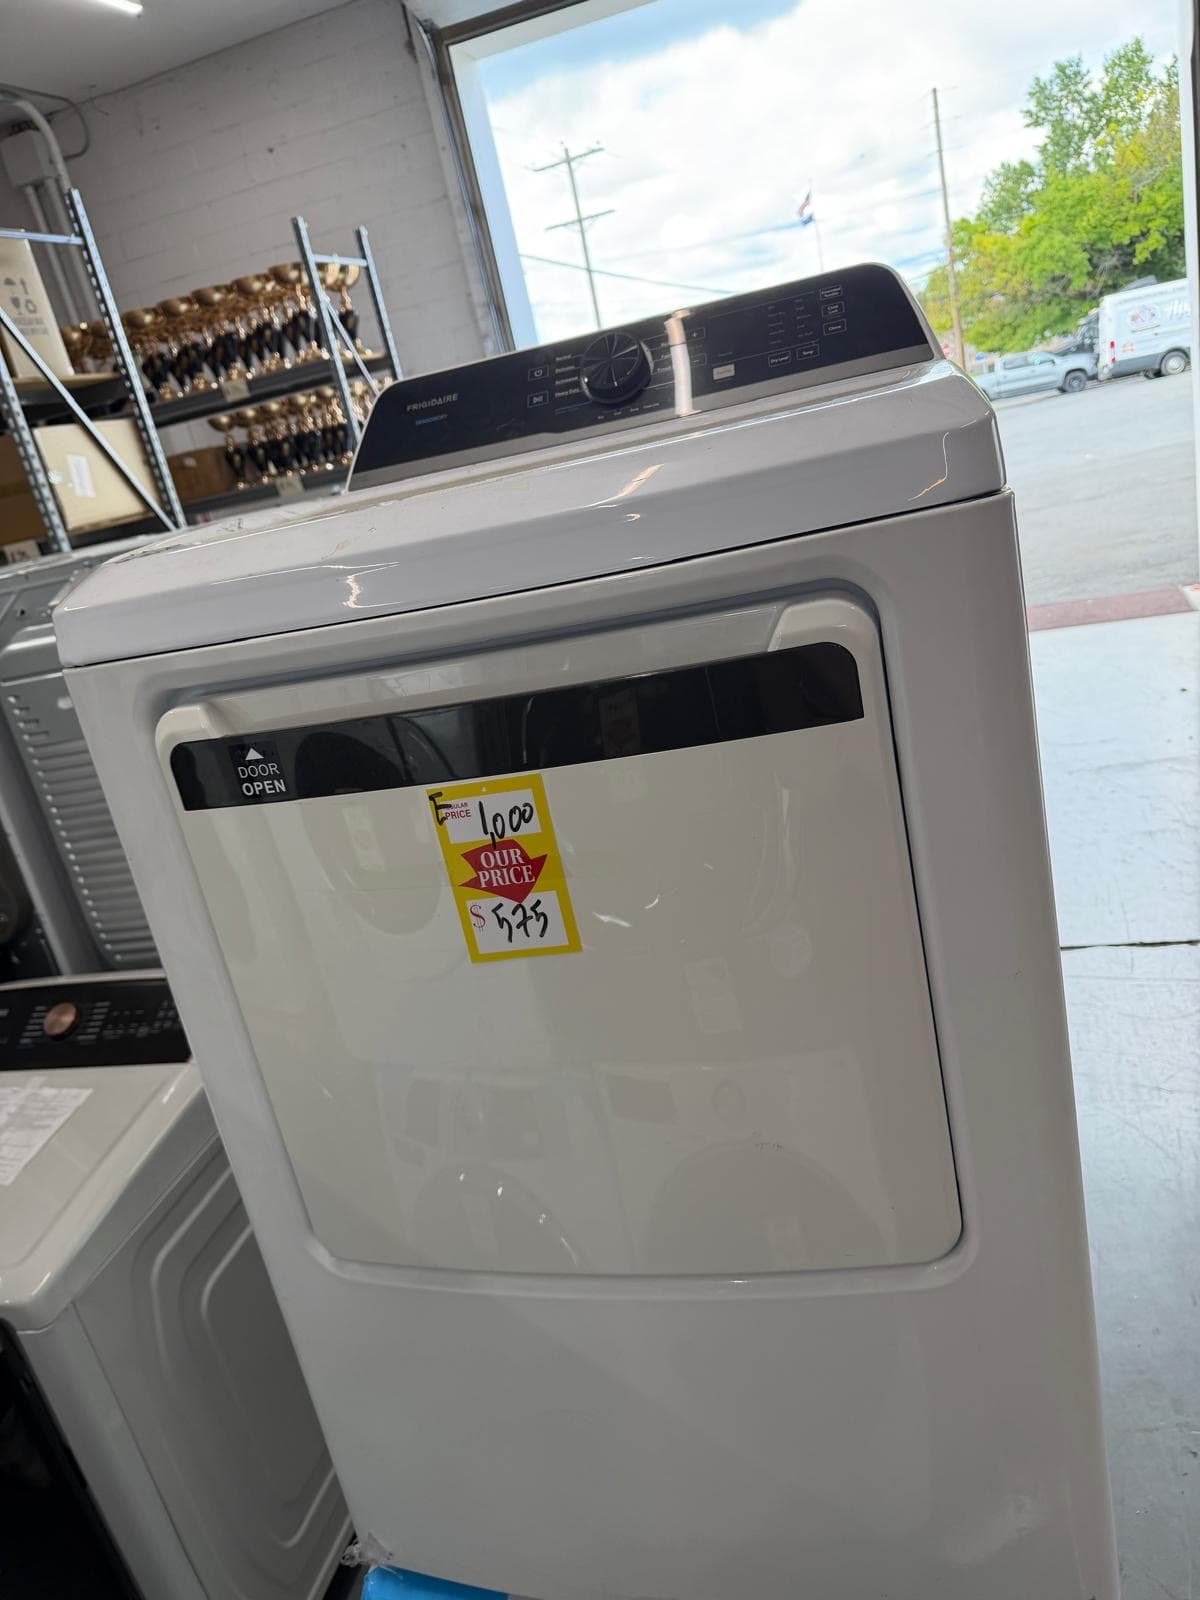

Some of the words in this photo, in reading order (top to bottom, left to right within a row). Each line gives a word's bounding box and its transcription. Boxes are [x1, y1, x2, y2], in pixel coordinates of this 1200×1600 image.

[406, 393, 459, 412] FRIGIDAIRE
[237, 763, 281, 779] DOOR
[242, 779, 287, 796] OPEN
[445, 809, 472, 821] PRICE
[479, 847, 525, 869] OUR
[477, 864, 536, 889] PRICE
